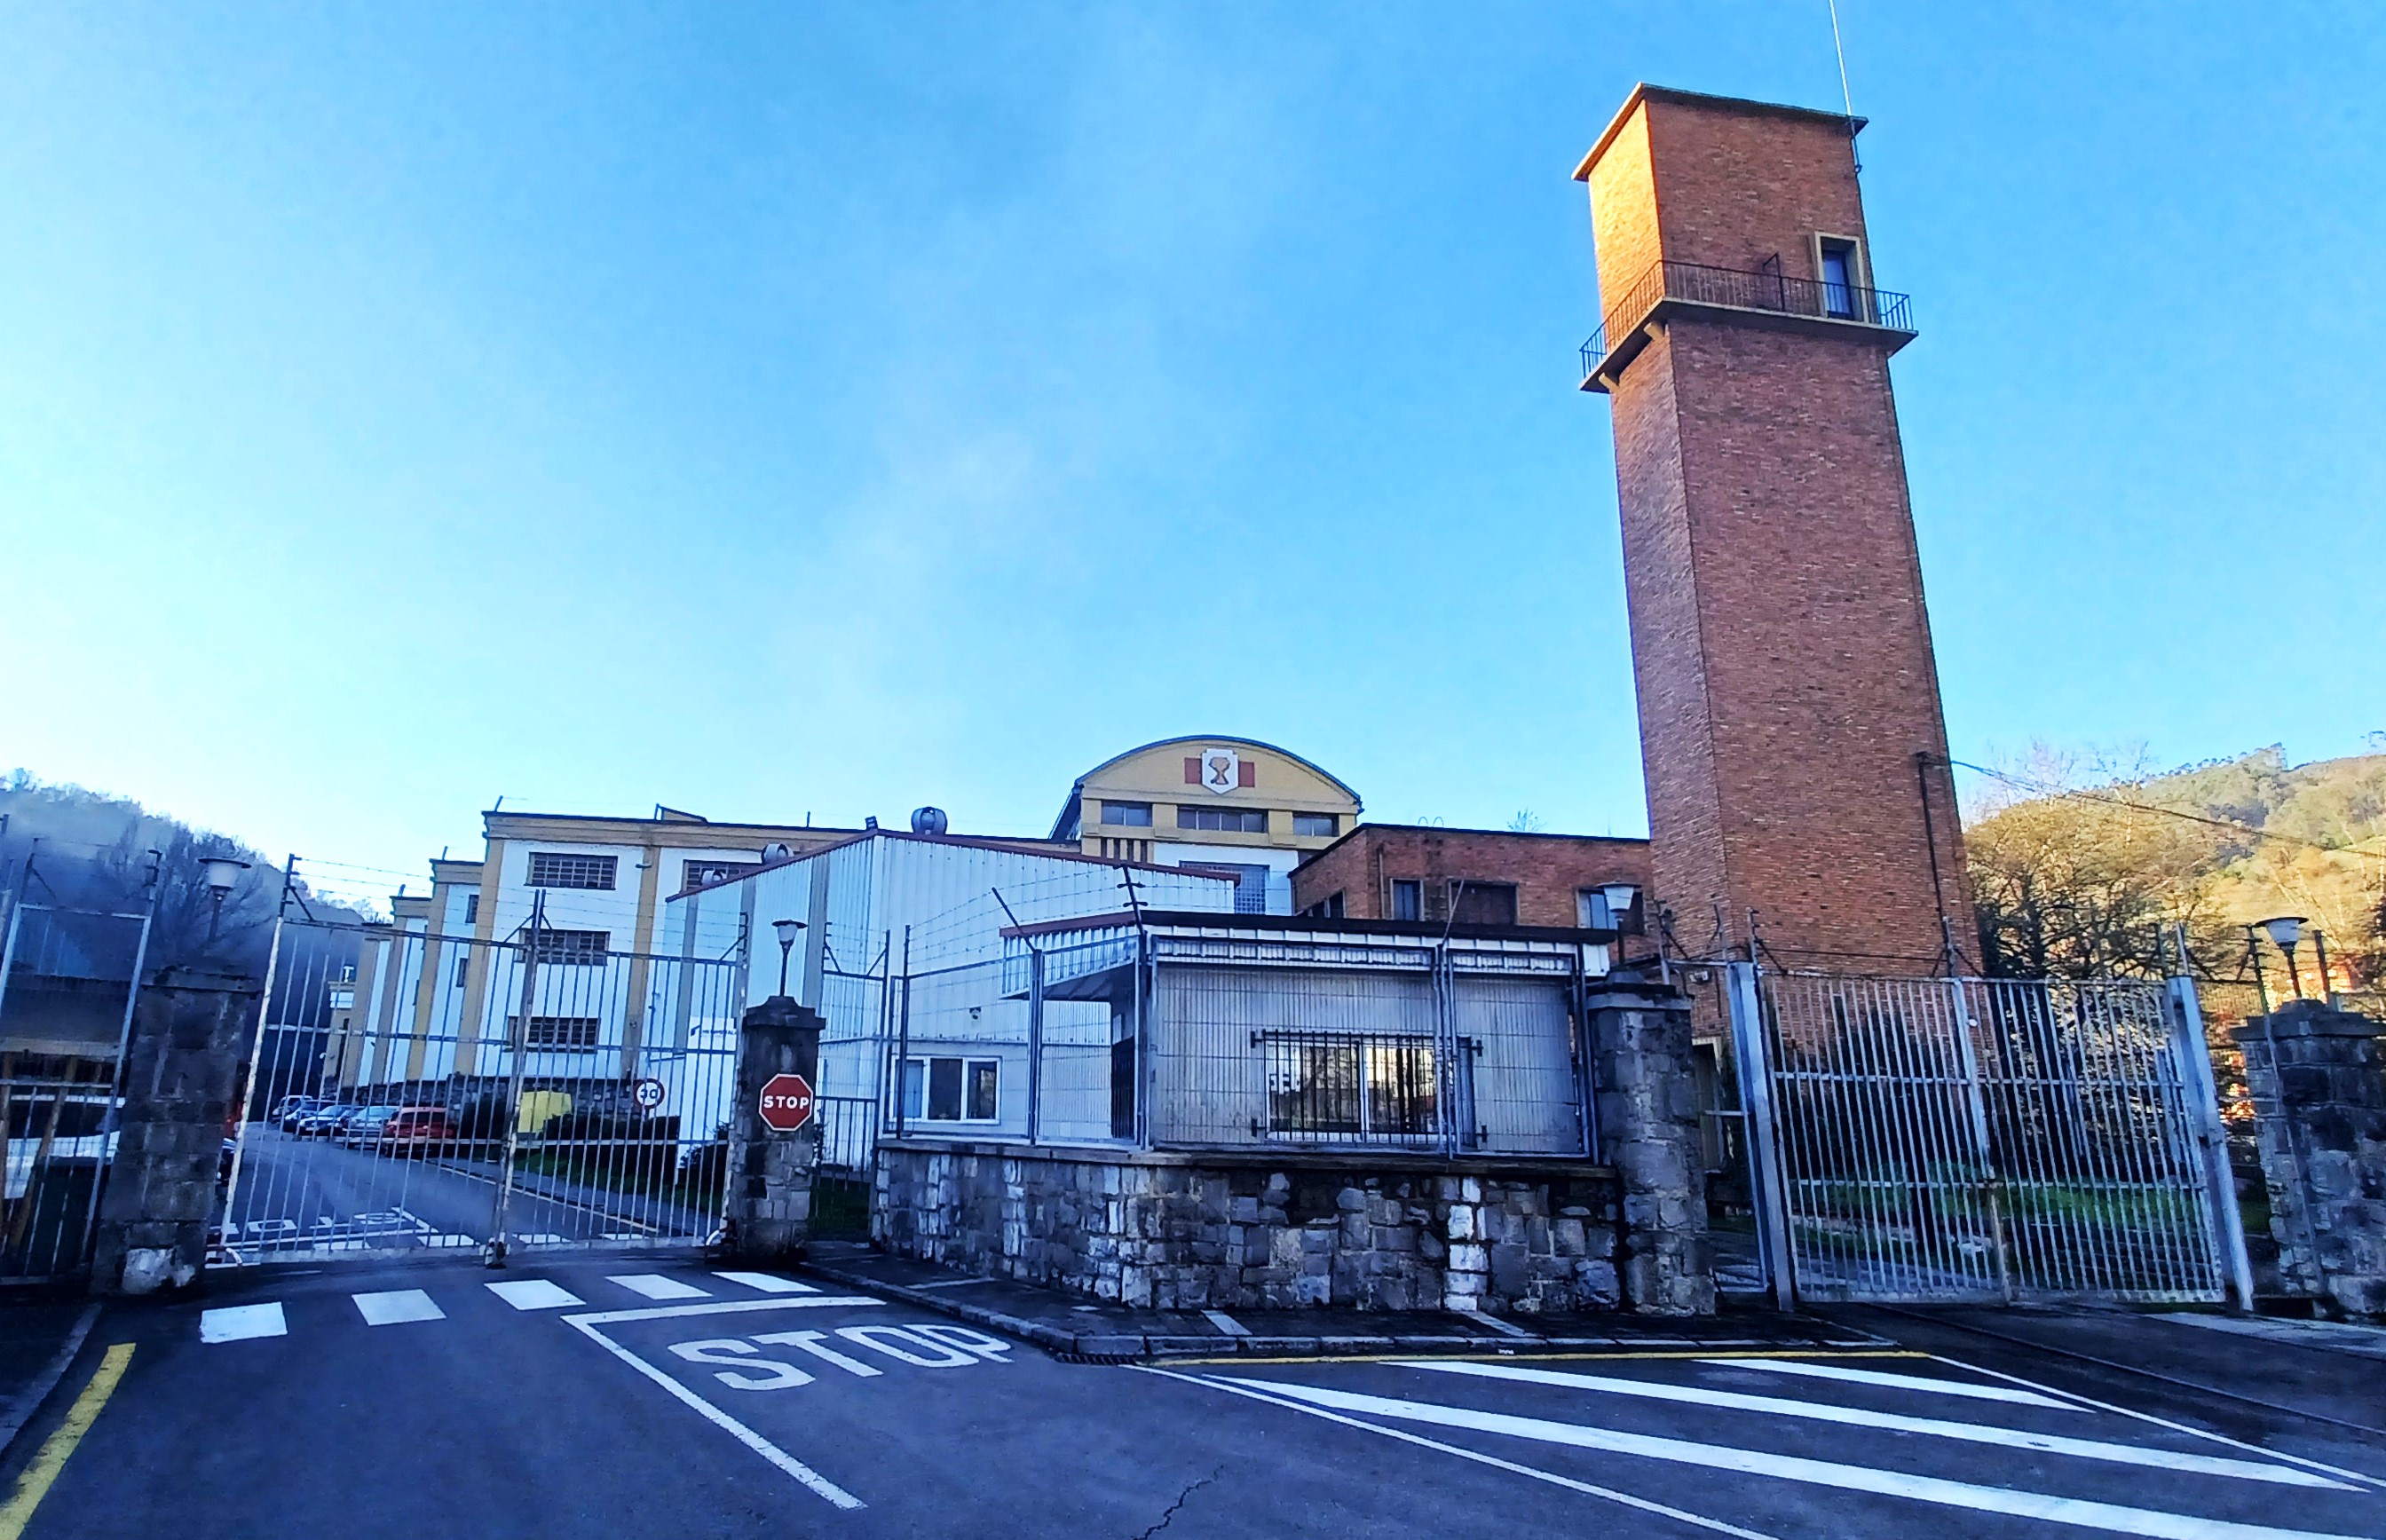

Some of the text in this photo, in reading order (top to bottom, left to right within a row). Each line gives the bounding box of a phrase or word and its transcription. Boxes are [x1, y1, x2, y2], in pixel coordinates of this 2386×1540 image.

[640, 1088, 659, 1100] 30
[763, 1095, 810, 1110] STOP
[667, 1323, 1015, 1391] STOP
